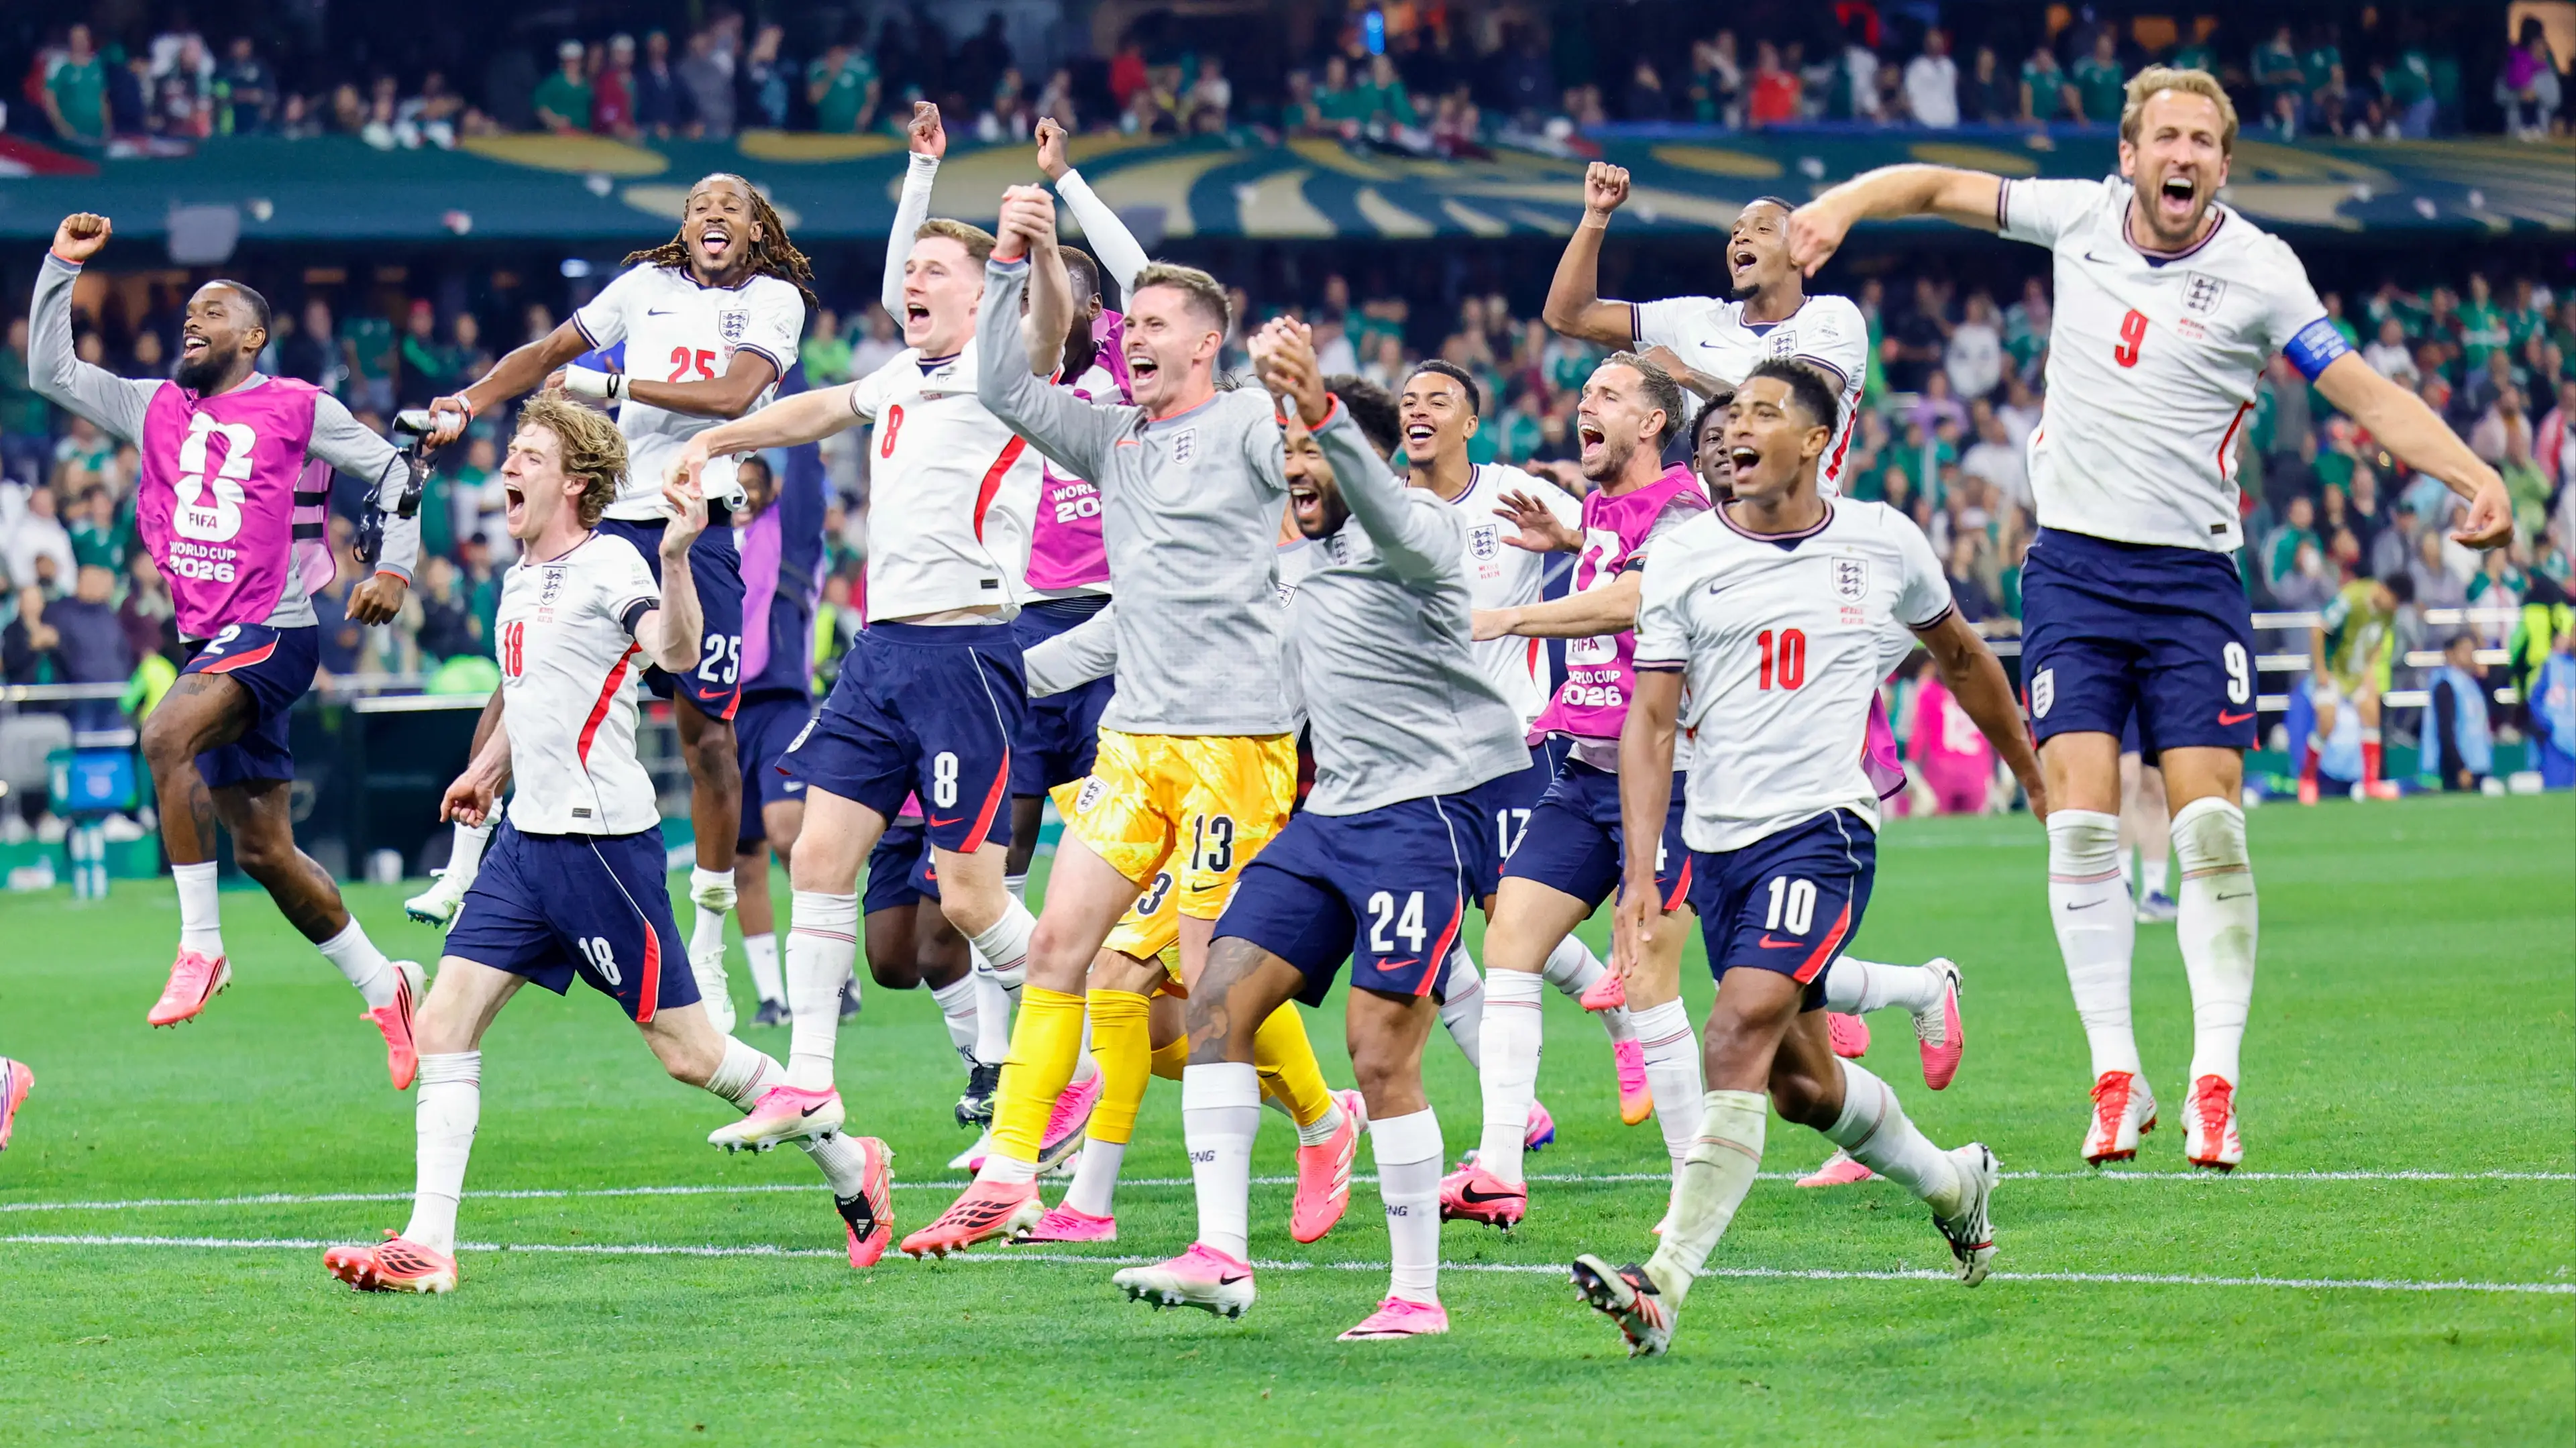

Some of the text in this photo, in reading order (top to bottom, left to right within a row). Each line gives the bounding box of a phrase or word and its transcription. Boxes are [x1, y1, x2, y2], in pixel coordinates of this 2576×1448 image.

[2115, 309, 2149, 368] 9
[667, 346, 716, 384] 25
[881, 404, 904, 458] 8
[1053, 484, 1100, 501] WORL
[1055, 497, 1102, 523] 20
[189, 512, 217, 528] FIFA
[170, 541, 236, 561] WORLD CUP
[170, 555, 235, 583] 2026
[204, 624, 241, 655] 2
[504, 622, 524, 677] 18
[698, 633, 741, 684] 25
[1572, 636, 1600, 653] FIFA
[1758, 628, 1805, 690] 10
[1568, 670, 1621, 684] RLD CUP
[2222, 641, 2250, 705] 9
[934, 751, 958, 808] 8
[1192, 815, 1233, 872] 13
[1497, 808, 1532, 858] 17
[1137, 872, 1173, 915] 3
[1765, 876, 1817, 936] 10
[1368, 891, 1427, 952] 24
[578, 937, 622, 985] 18
